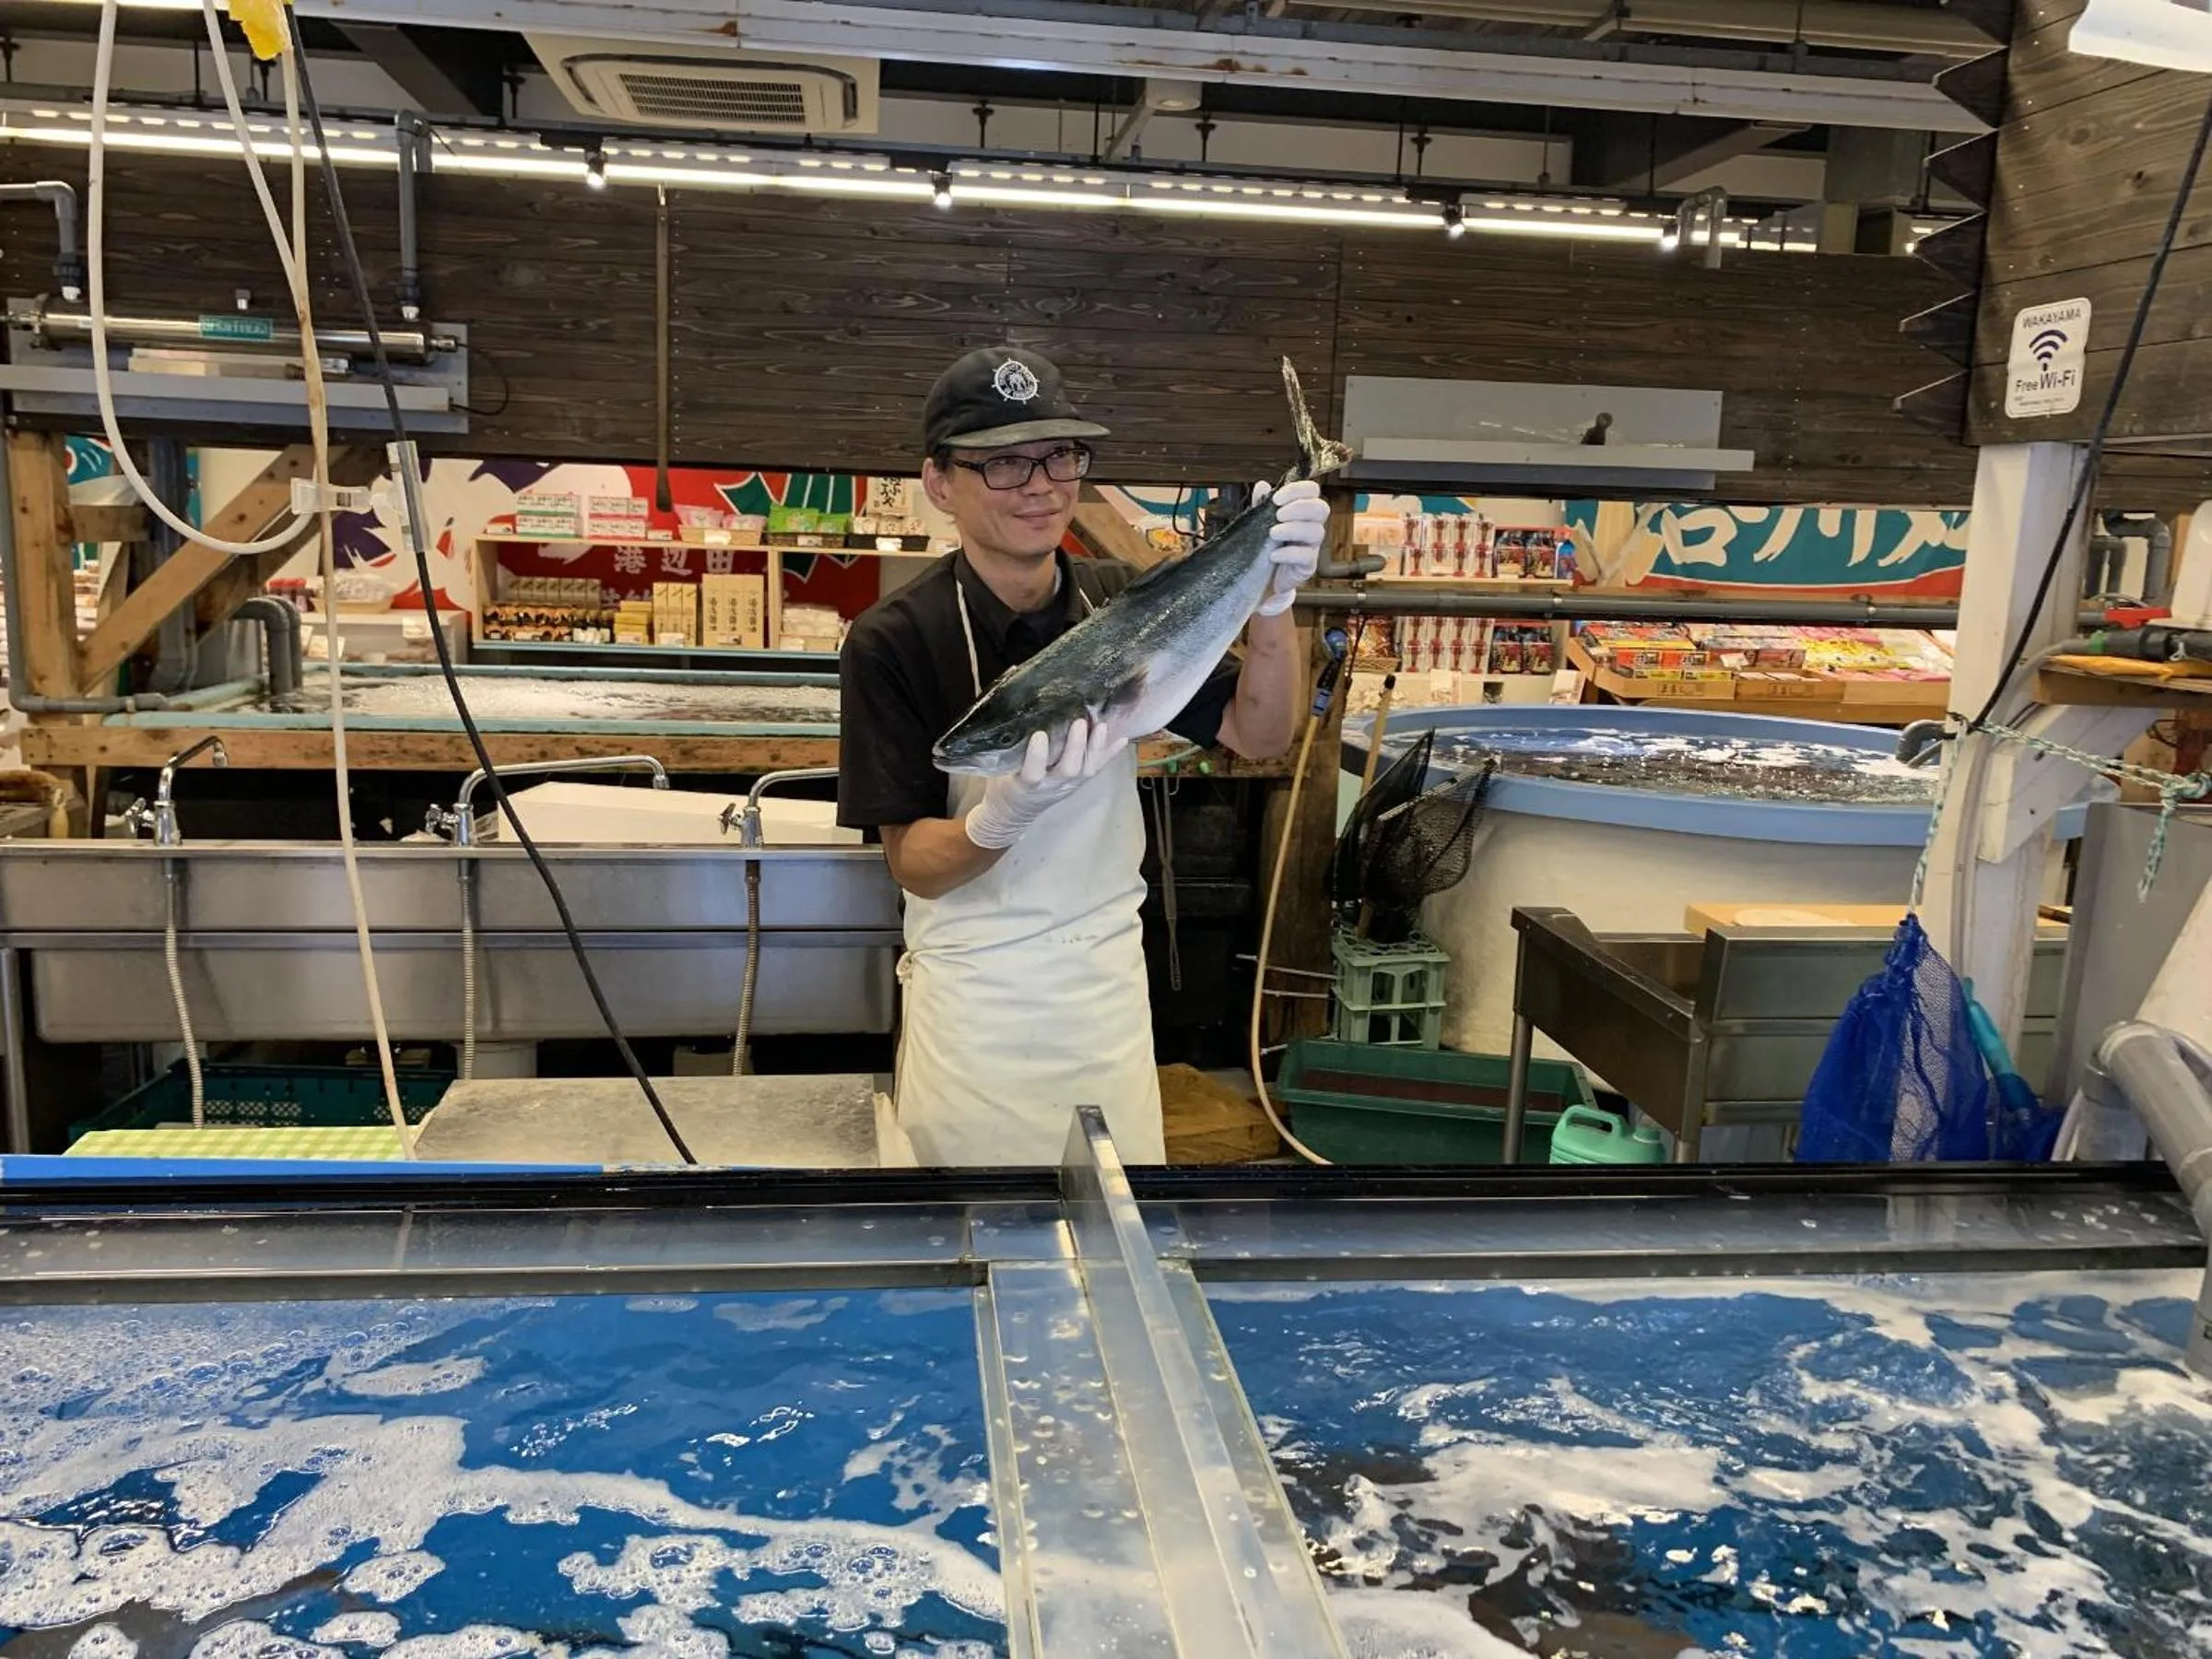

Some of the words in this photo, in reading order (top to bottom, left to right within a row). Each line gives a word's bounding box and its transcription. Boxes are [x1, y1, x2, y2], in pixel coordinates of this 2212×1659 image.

[2022, 309, 2081, 328] WAKAYAMA
[2015, 379, 2039, 393] Free
[2040, 371, 2076, 390] Wi-Fi
